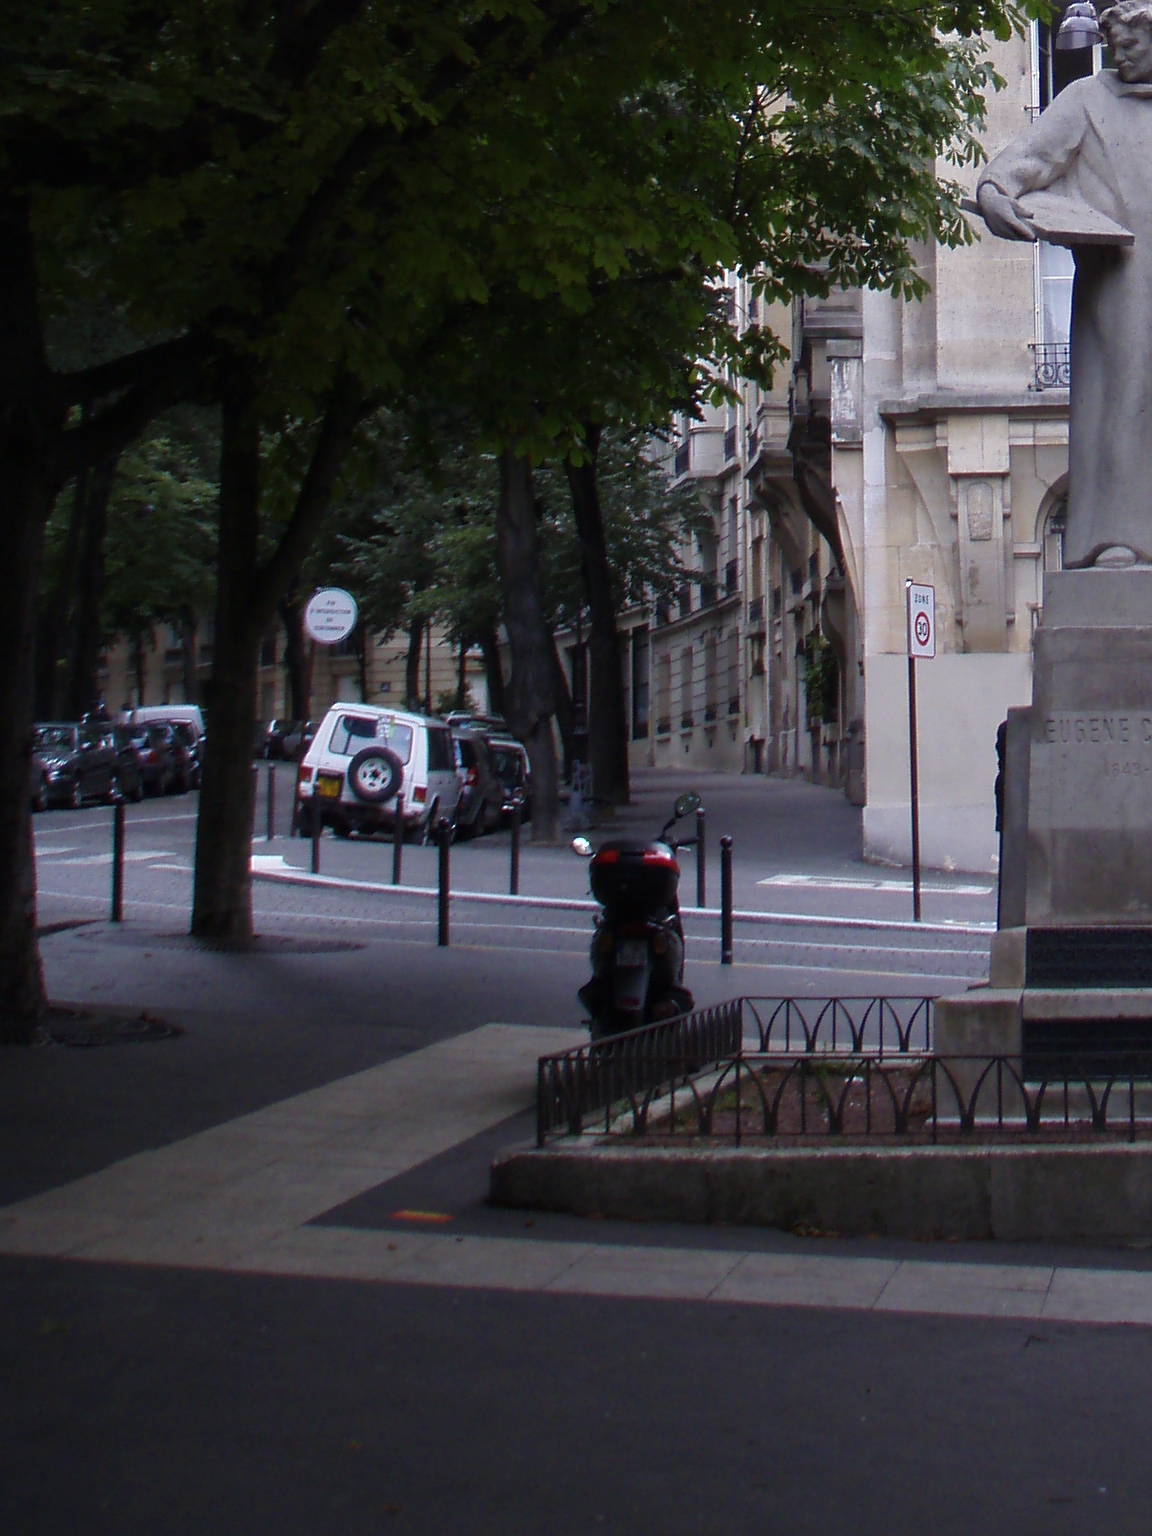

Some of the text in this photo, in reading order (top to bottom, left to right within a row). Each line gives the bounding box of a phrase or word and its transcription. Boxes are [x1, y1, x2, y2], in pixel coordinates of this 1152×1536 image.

[914, 593, 929, 604] ZONE
[918, 622, 928, 636] 30
[1045, 718, 1129, 743] EUGENE
